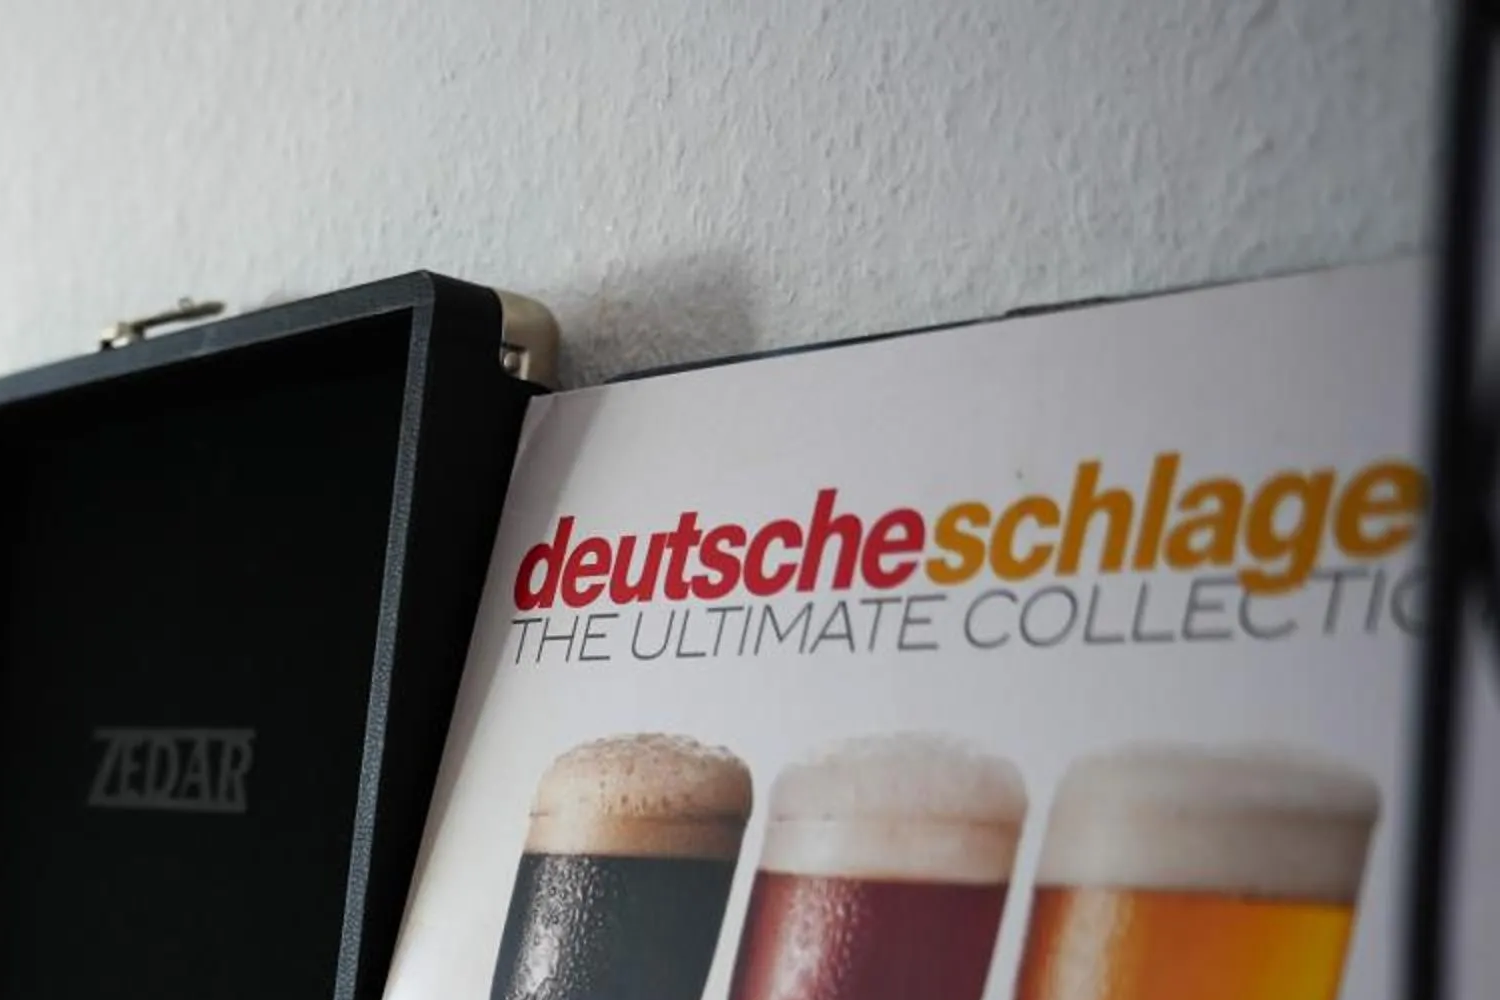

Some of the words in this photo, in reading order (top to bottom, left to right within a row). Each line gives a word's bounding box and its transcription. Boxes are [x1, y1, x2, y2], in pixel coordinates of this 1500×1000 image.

[511, 612, 620, 665] THE
[631, 593, 947, 661] ULTIMATE
[88, 727, 256, 813] ZEDAR
